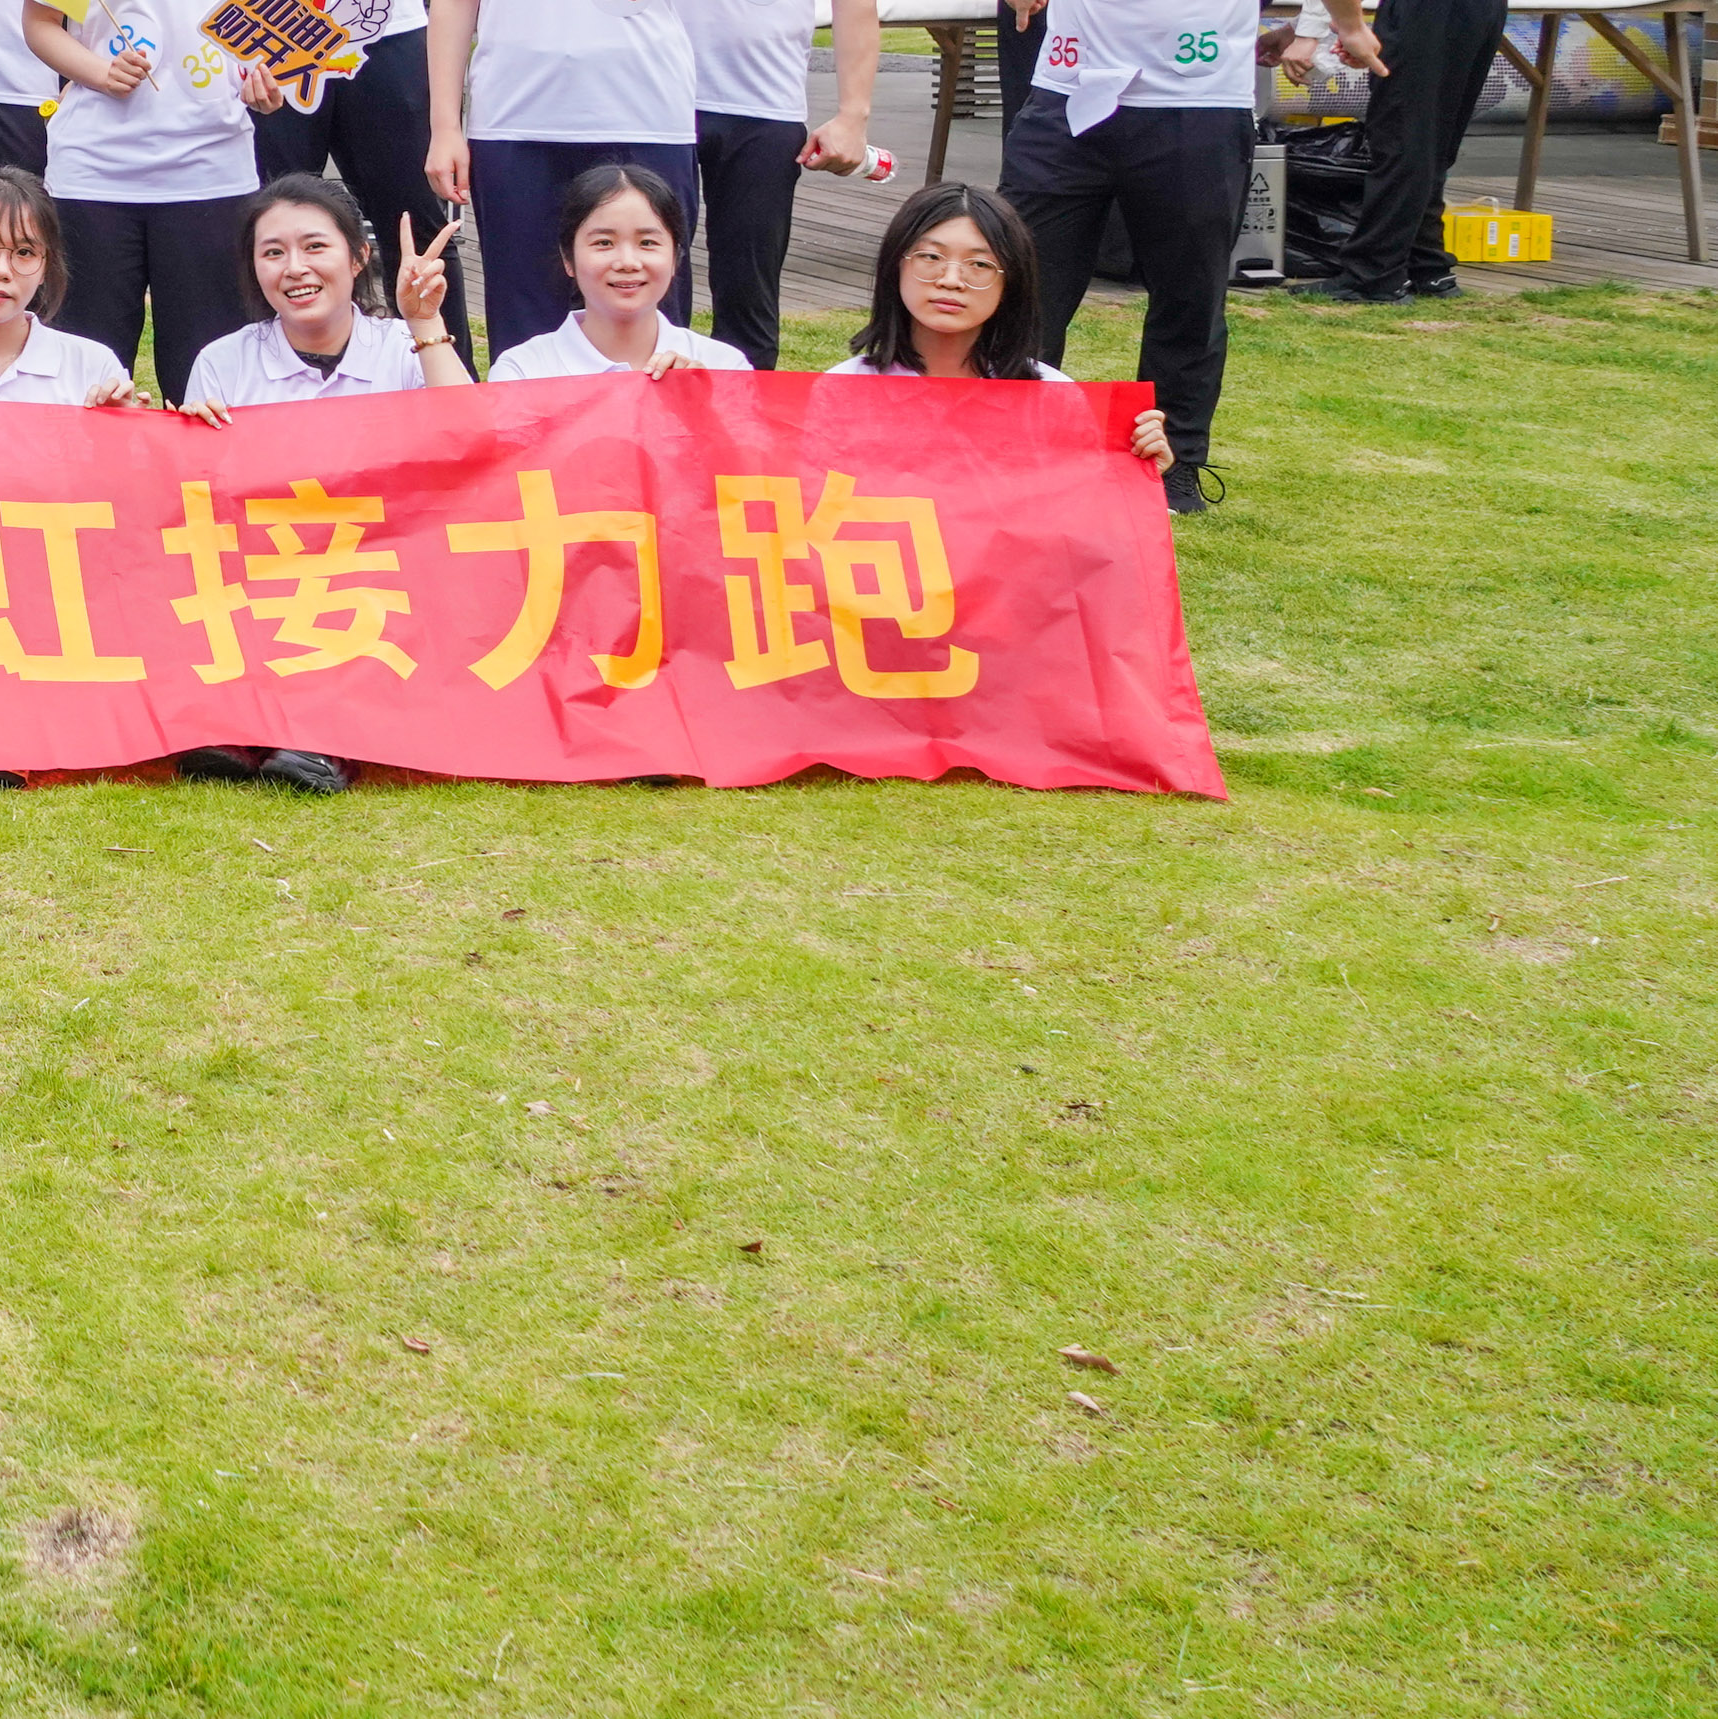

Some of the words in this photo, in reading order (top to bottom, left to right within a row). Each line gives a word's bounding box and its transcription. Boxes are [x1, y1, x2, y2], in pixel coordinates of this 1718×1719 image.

[182, 40, 224, 89] 35
[206, 3, 321, 103] 财开人
[1048, 36, 1080, 68] 35
[1175, 30, 1220, 65] 35
